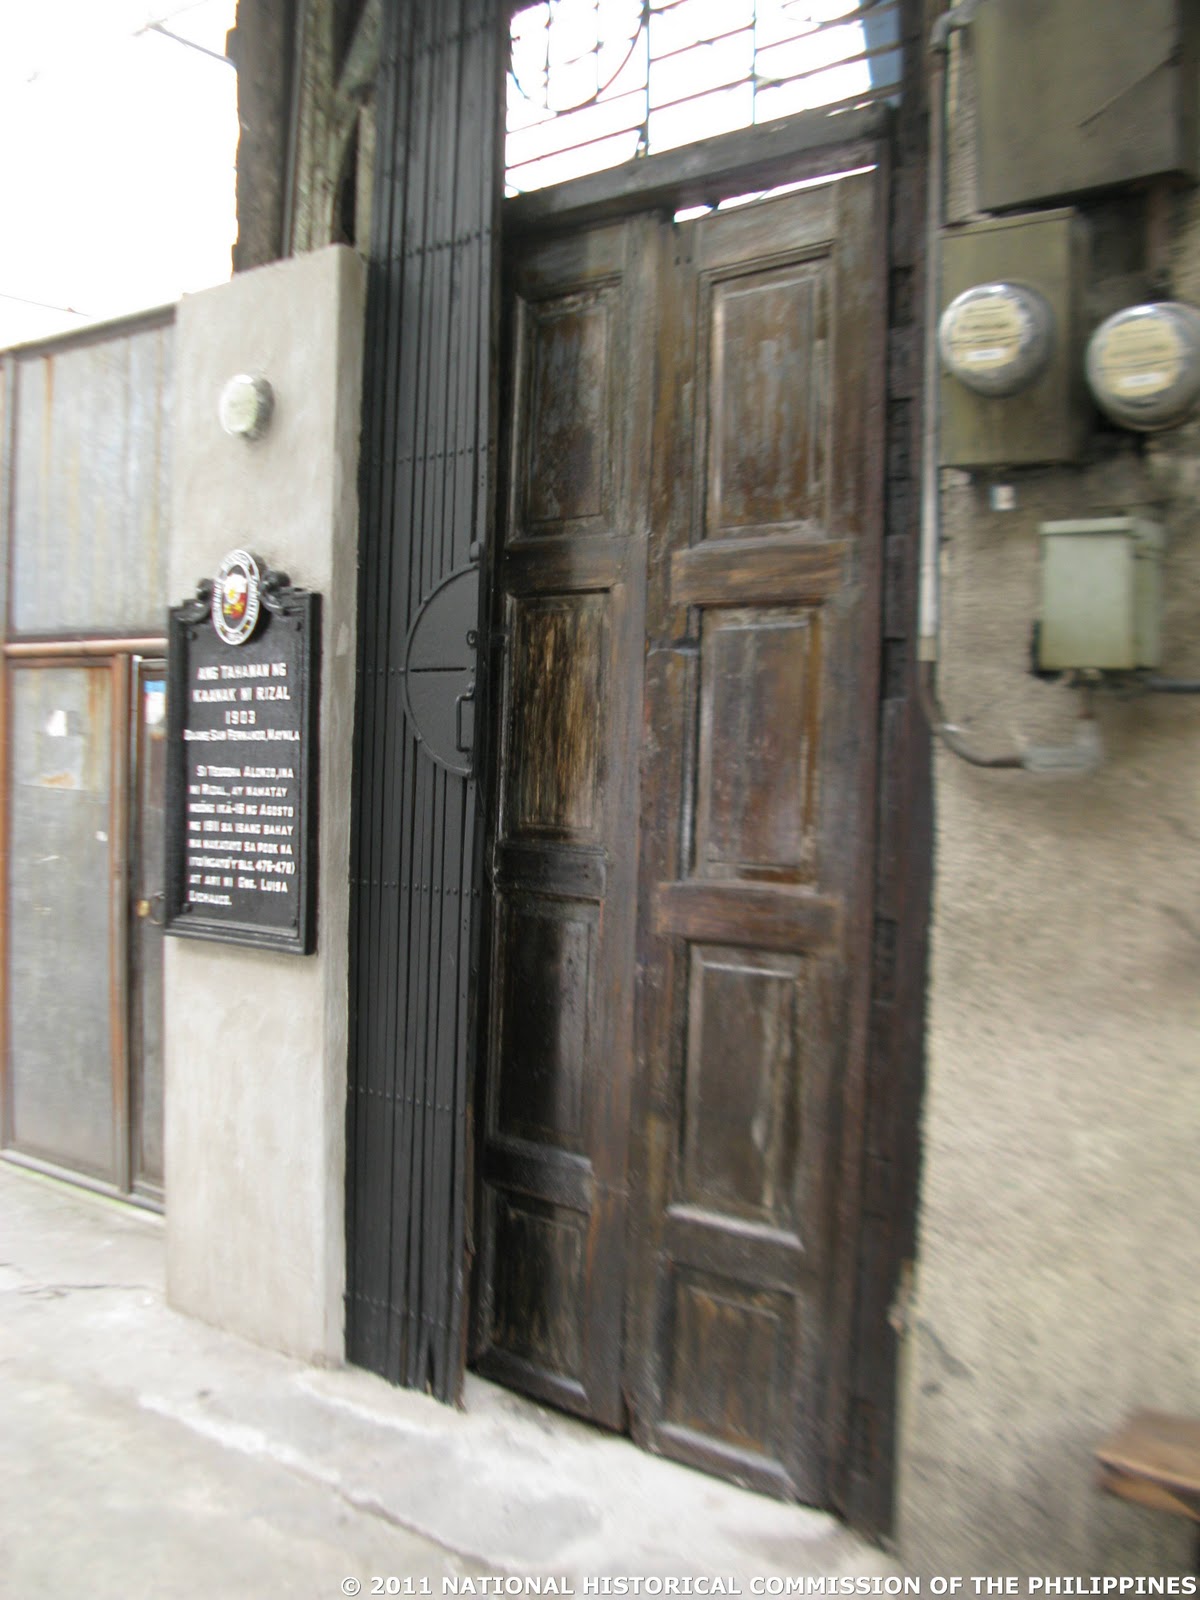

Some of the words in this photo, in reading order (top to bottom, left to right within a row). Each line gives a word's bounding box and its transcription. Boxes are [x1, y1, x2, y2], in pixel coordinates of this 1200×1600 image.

[197, 666, 219, 680] ANG
[271, 662, 287, 677] NG
[255, 686, 291, 701] RIZAL
[225, 710, 256, 725] 1903
